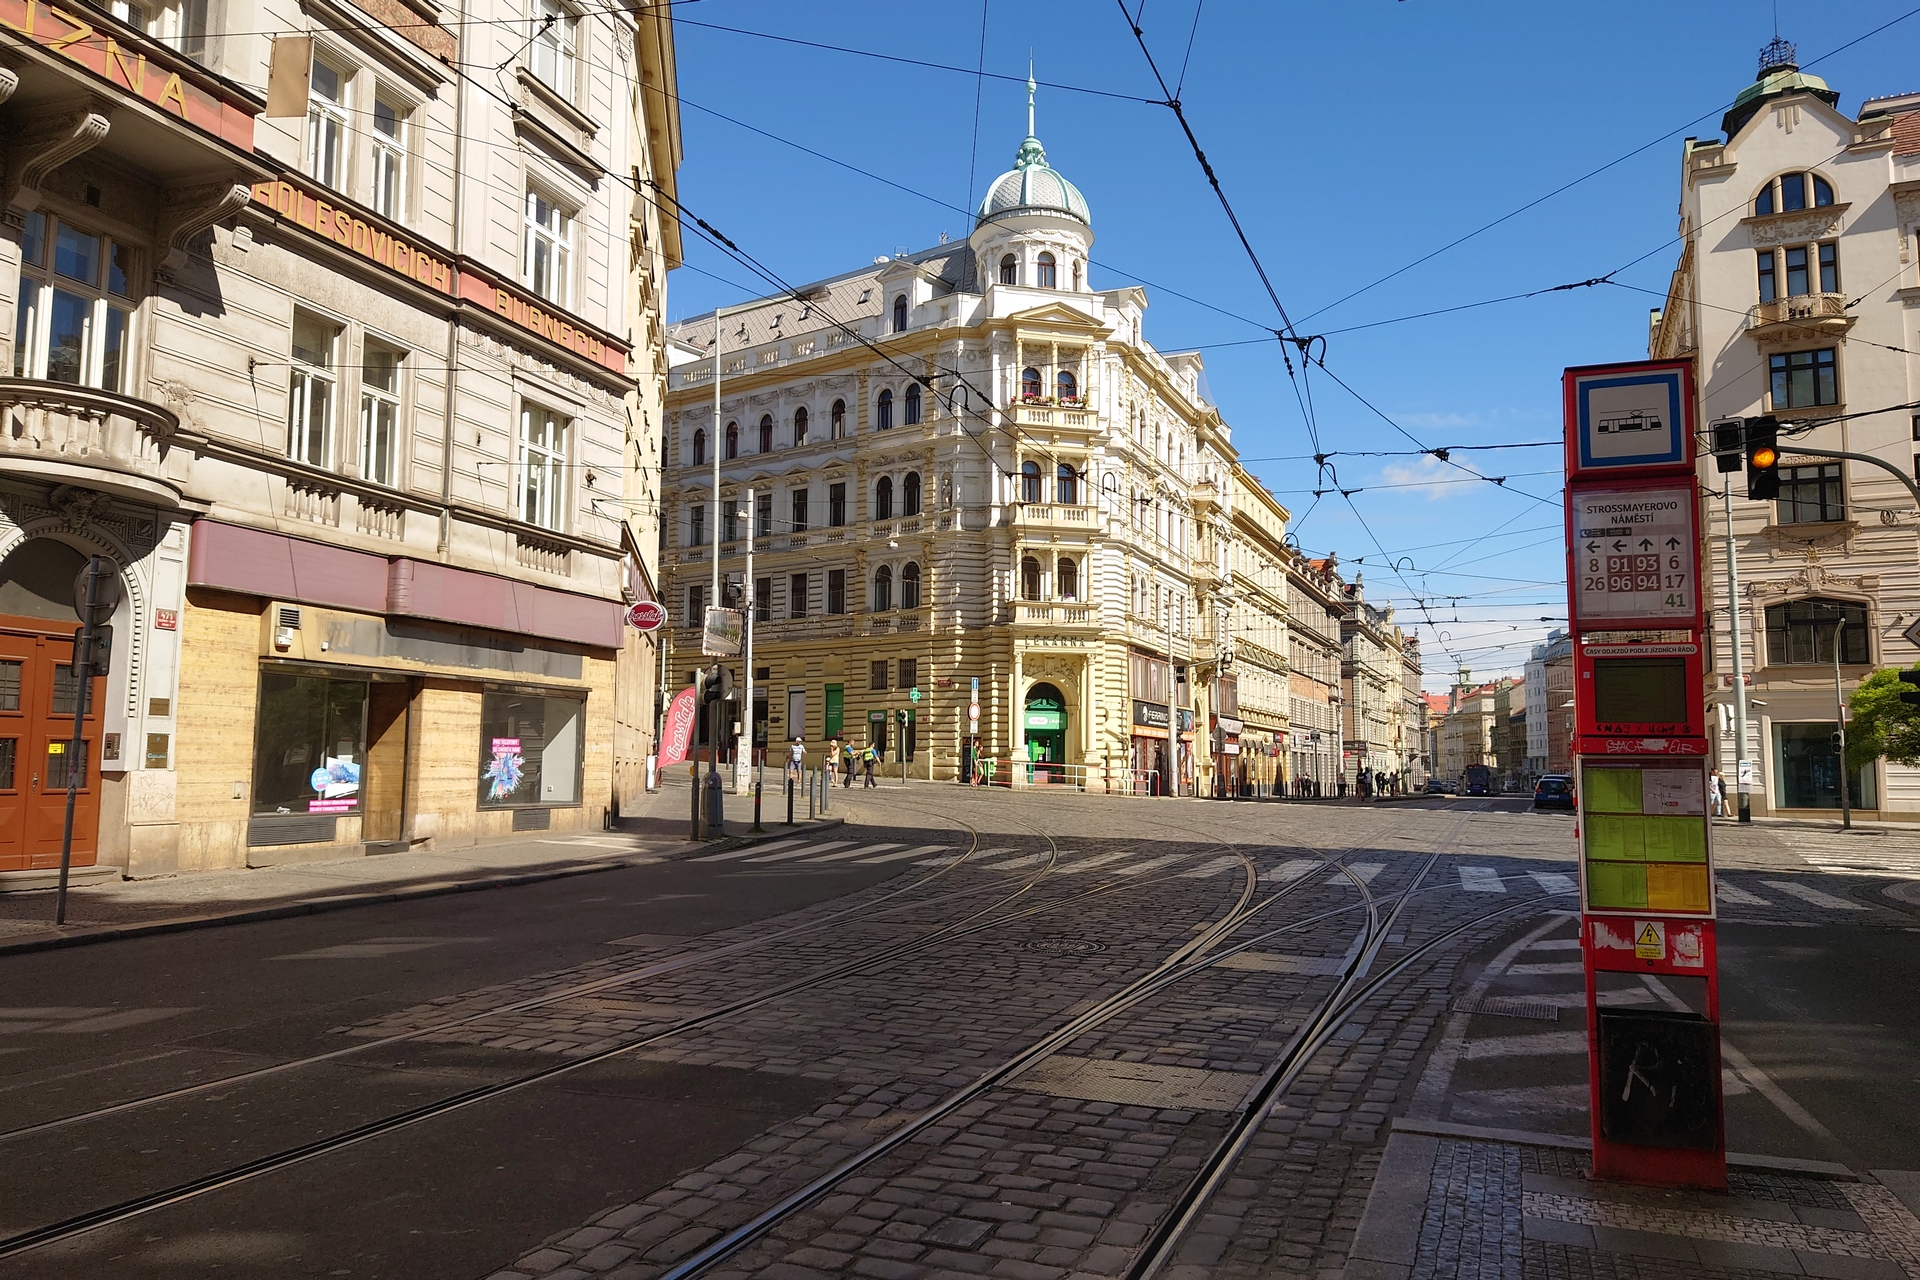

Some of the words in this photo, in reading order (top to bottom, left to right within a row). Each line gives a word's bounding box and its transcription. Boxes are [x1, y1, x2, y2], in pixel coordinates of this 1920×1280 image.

[495, 288, 601, 363] BUBNECH
[1587, 501, 1678, 514] STROSSMAYEROVO
[1611, 513, 1654, 524] NÁMĚSTÍ
[1589, 559, 1600, 572] 8
[1609, 557, 1631, 572] 91
[1636, 556, 1658, 571] 93
[1668, 555, 1680, 569] 6
[1584, 577, 1605, 591] 26
[1610, 576, 1632, 590] 96
[1637, 575, 1659, 589] 94
[1665, 574, 1685, 588] 17
[1665, 593, 1686, 607] 41
[1585, 646, 1601, 655] ČASY
[1602, 646, 1629, 654] ODJEZDŮ
[1650, 645, 1677, 654] JÍZDNÍCH
[1678, 644, 1695, 653] ŘÁDŮ
